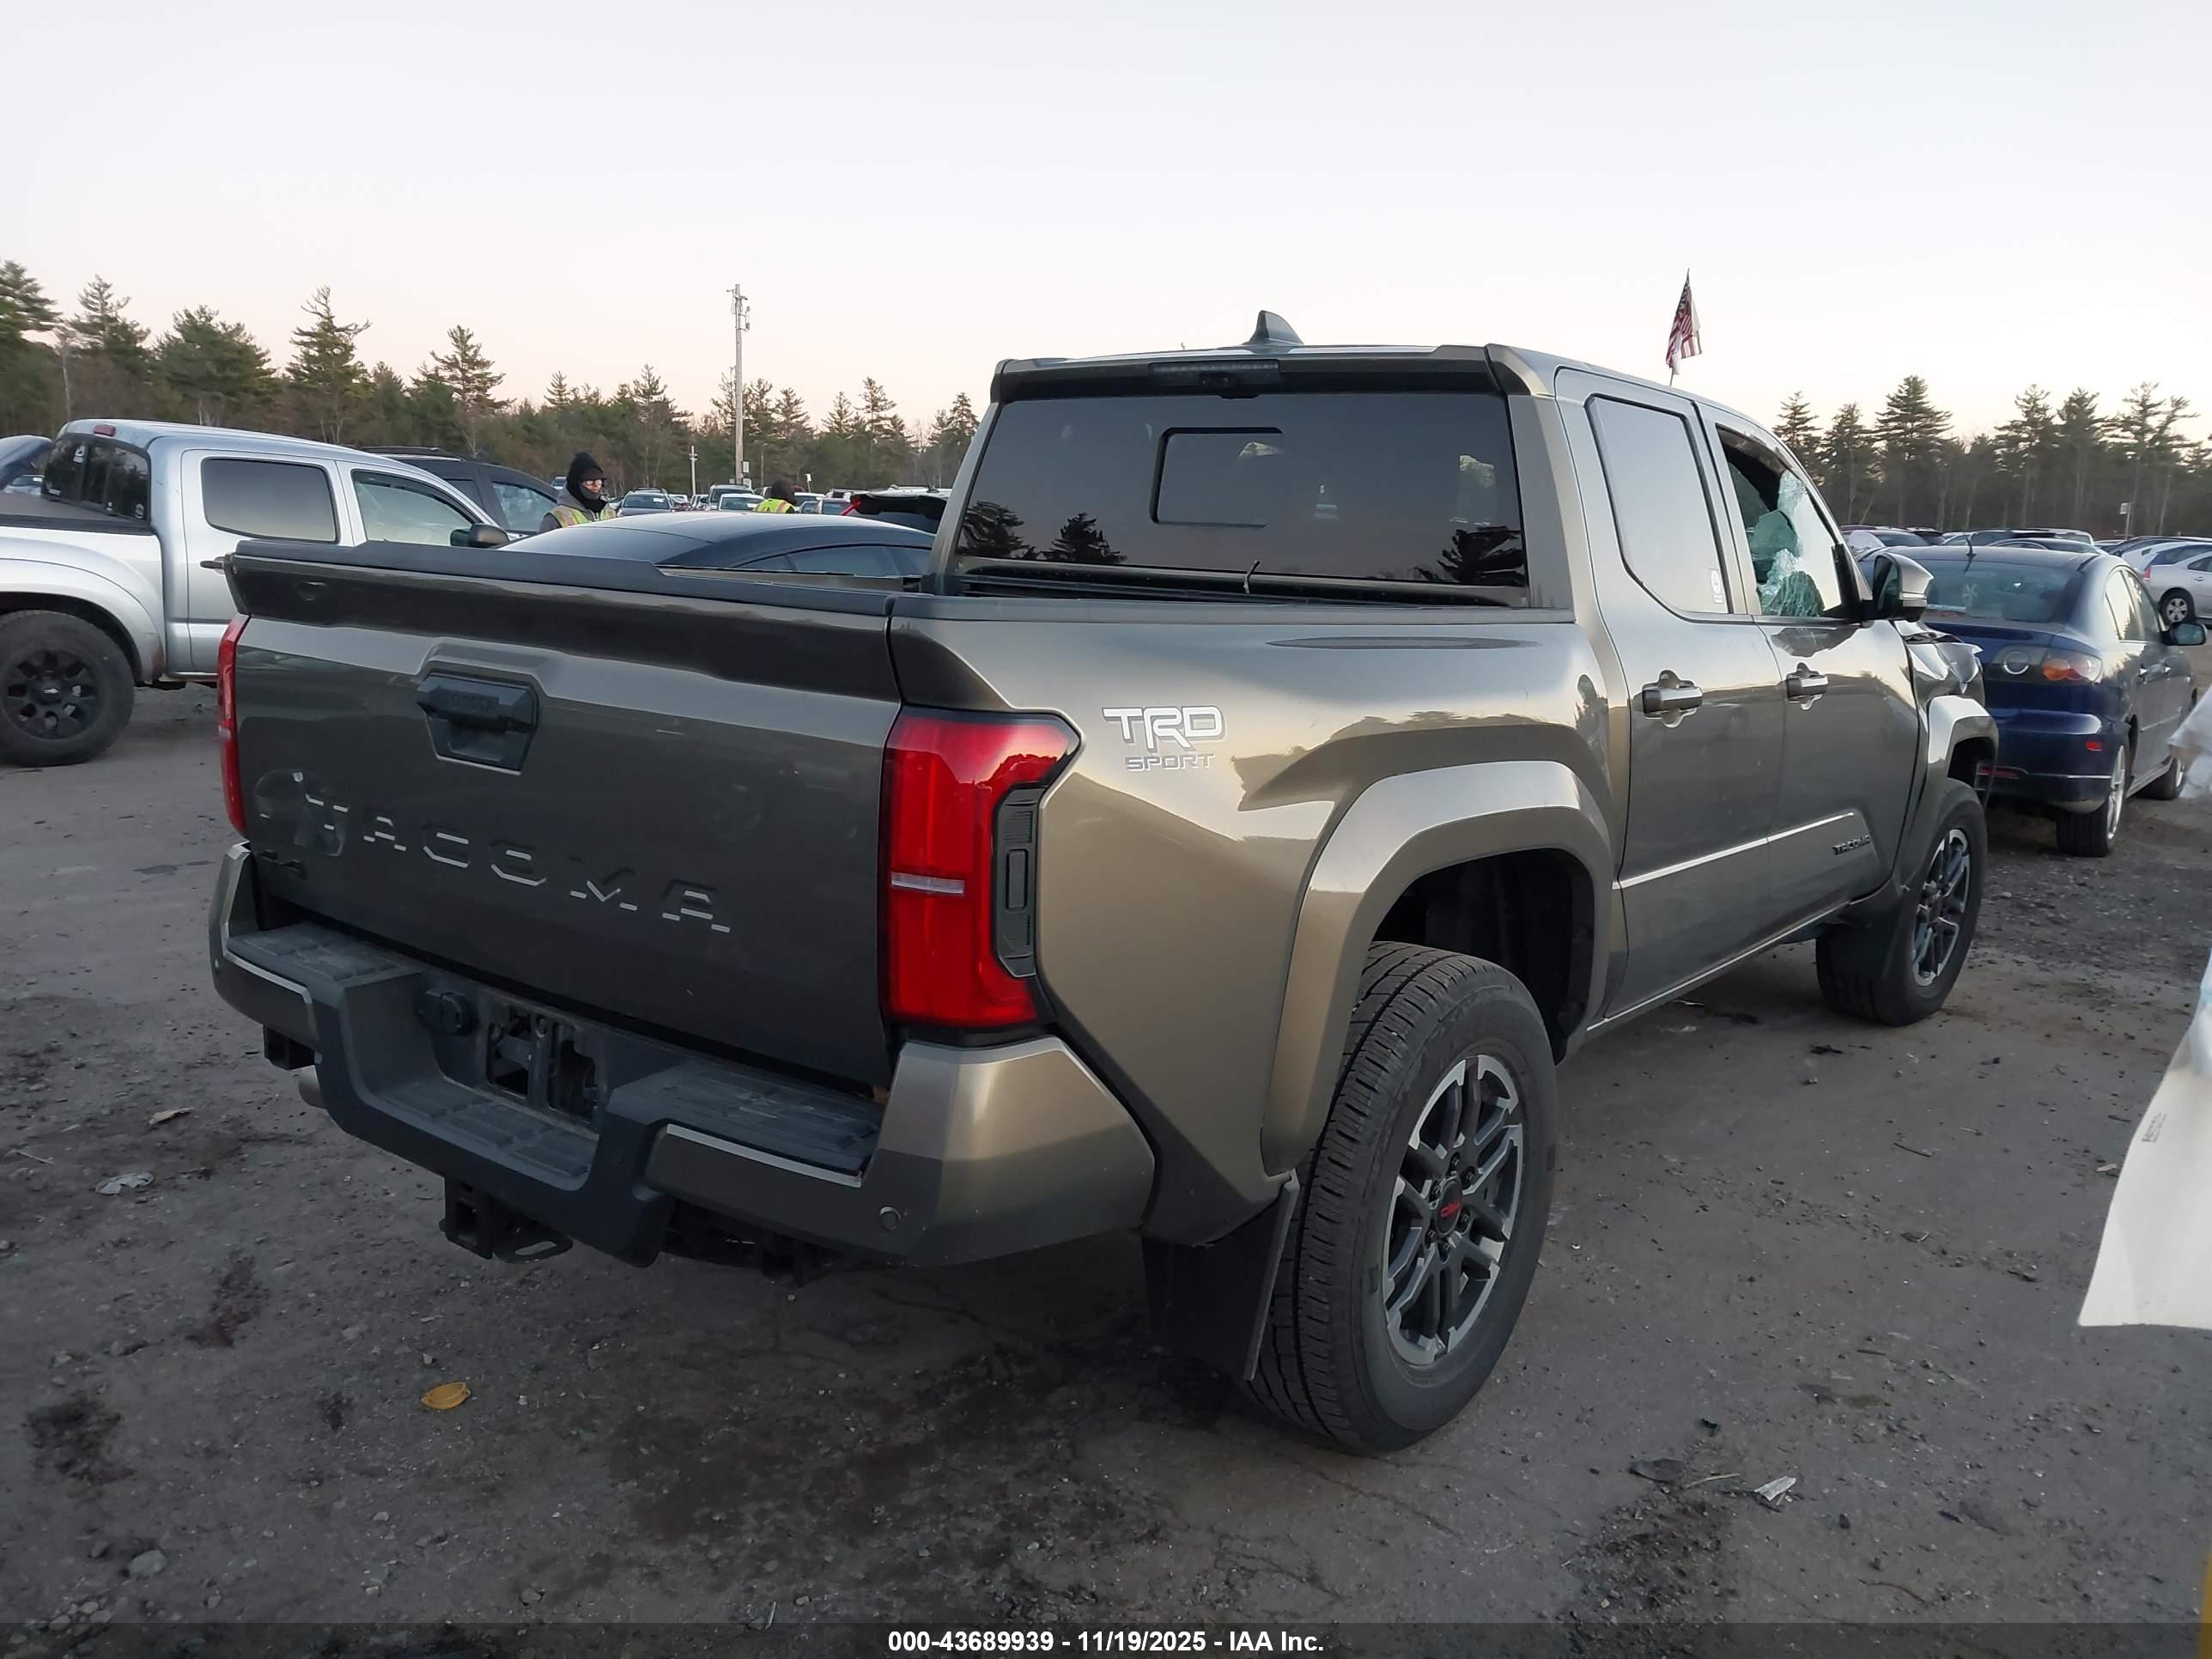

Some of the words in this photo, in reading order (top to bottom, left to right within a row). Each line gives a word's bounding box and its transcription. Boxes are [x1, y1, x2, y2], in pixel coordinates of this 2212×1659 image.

[1102, 705, 1225, 752] TRD
[1125, 753, 1216, 772] SPORT
[304, 790, 732, 933] TACOMA
